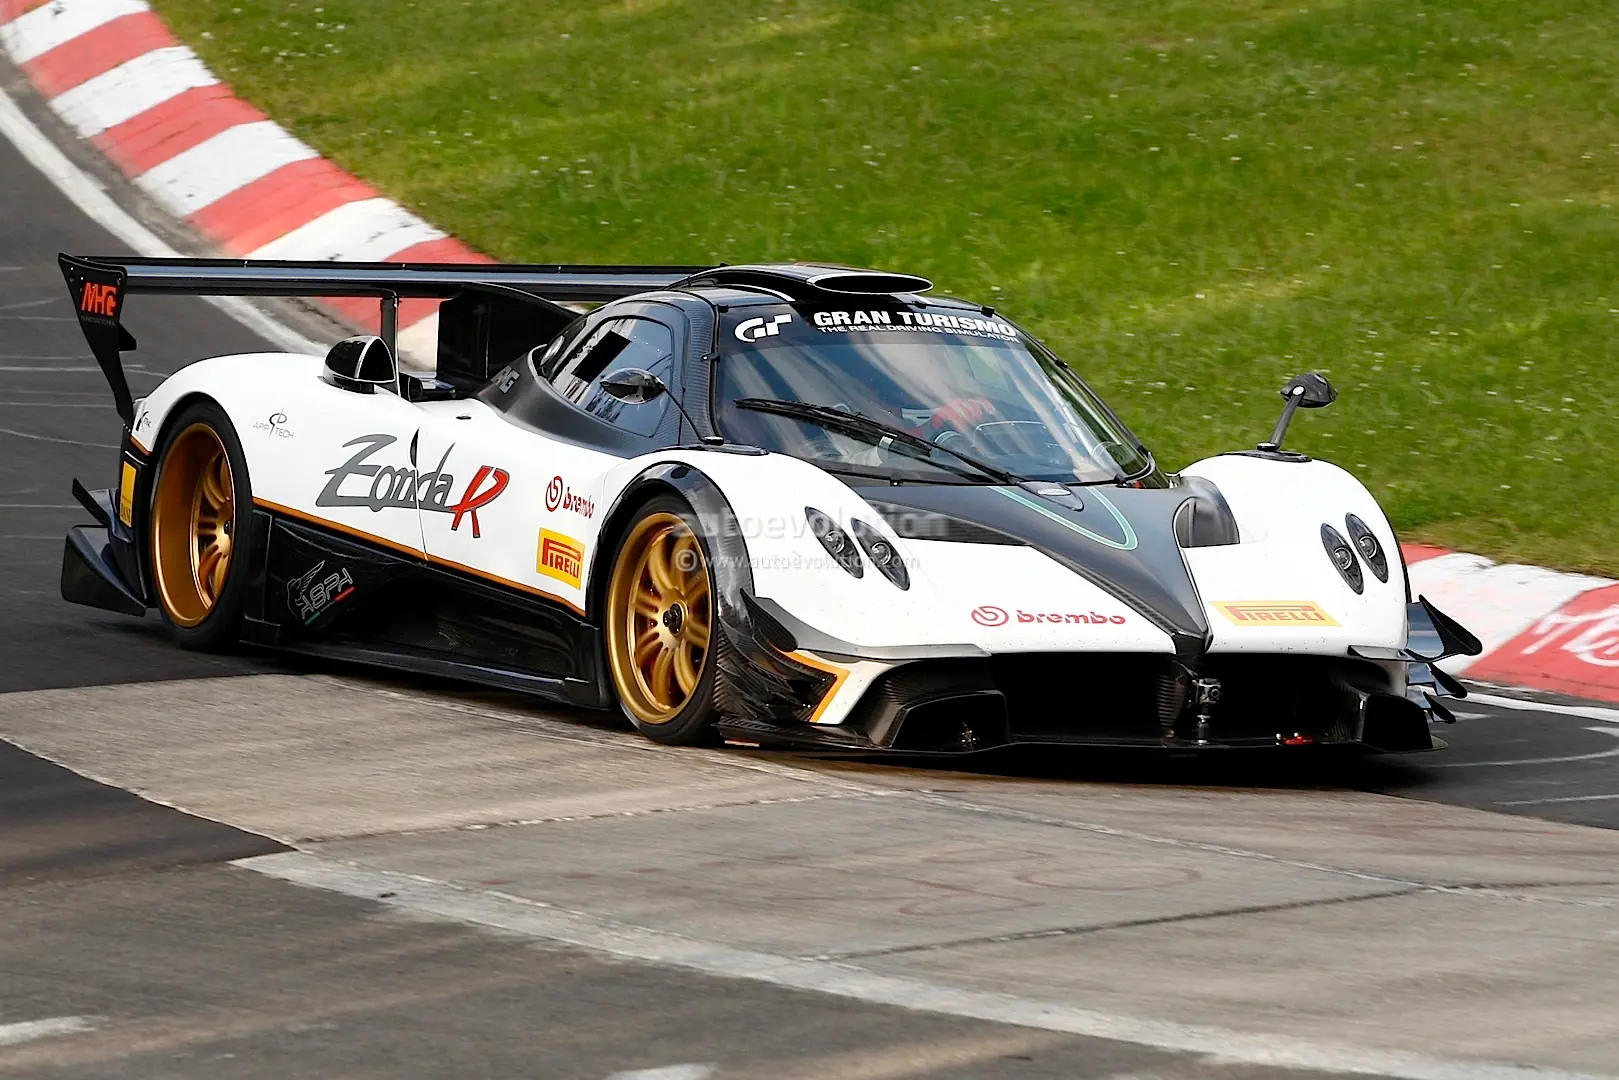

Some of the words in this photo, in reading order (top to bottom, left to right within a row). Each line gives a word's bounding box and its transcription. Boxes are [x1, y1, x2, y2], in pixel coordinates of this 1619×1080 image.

[813, 310, 891, 327] GRAN
[897, 311, 1017, 337] TURISMO
[886, 325, 942, 333] DRIVING
[943, 327, 1021, 344] SIMULATOR
[315, 434, 456, 513] Zonda
[449, 465, 511, 539] R
[541, 537, 581, 579] PIRELLI
[1015, 610, 1127, 626] brembo
[1224, 605, 1326, 621] PIRELLI
